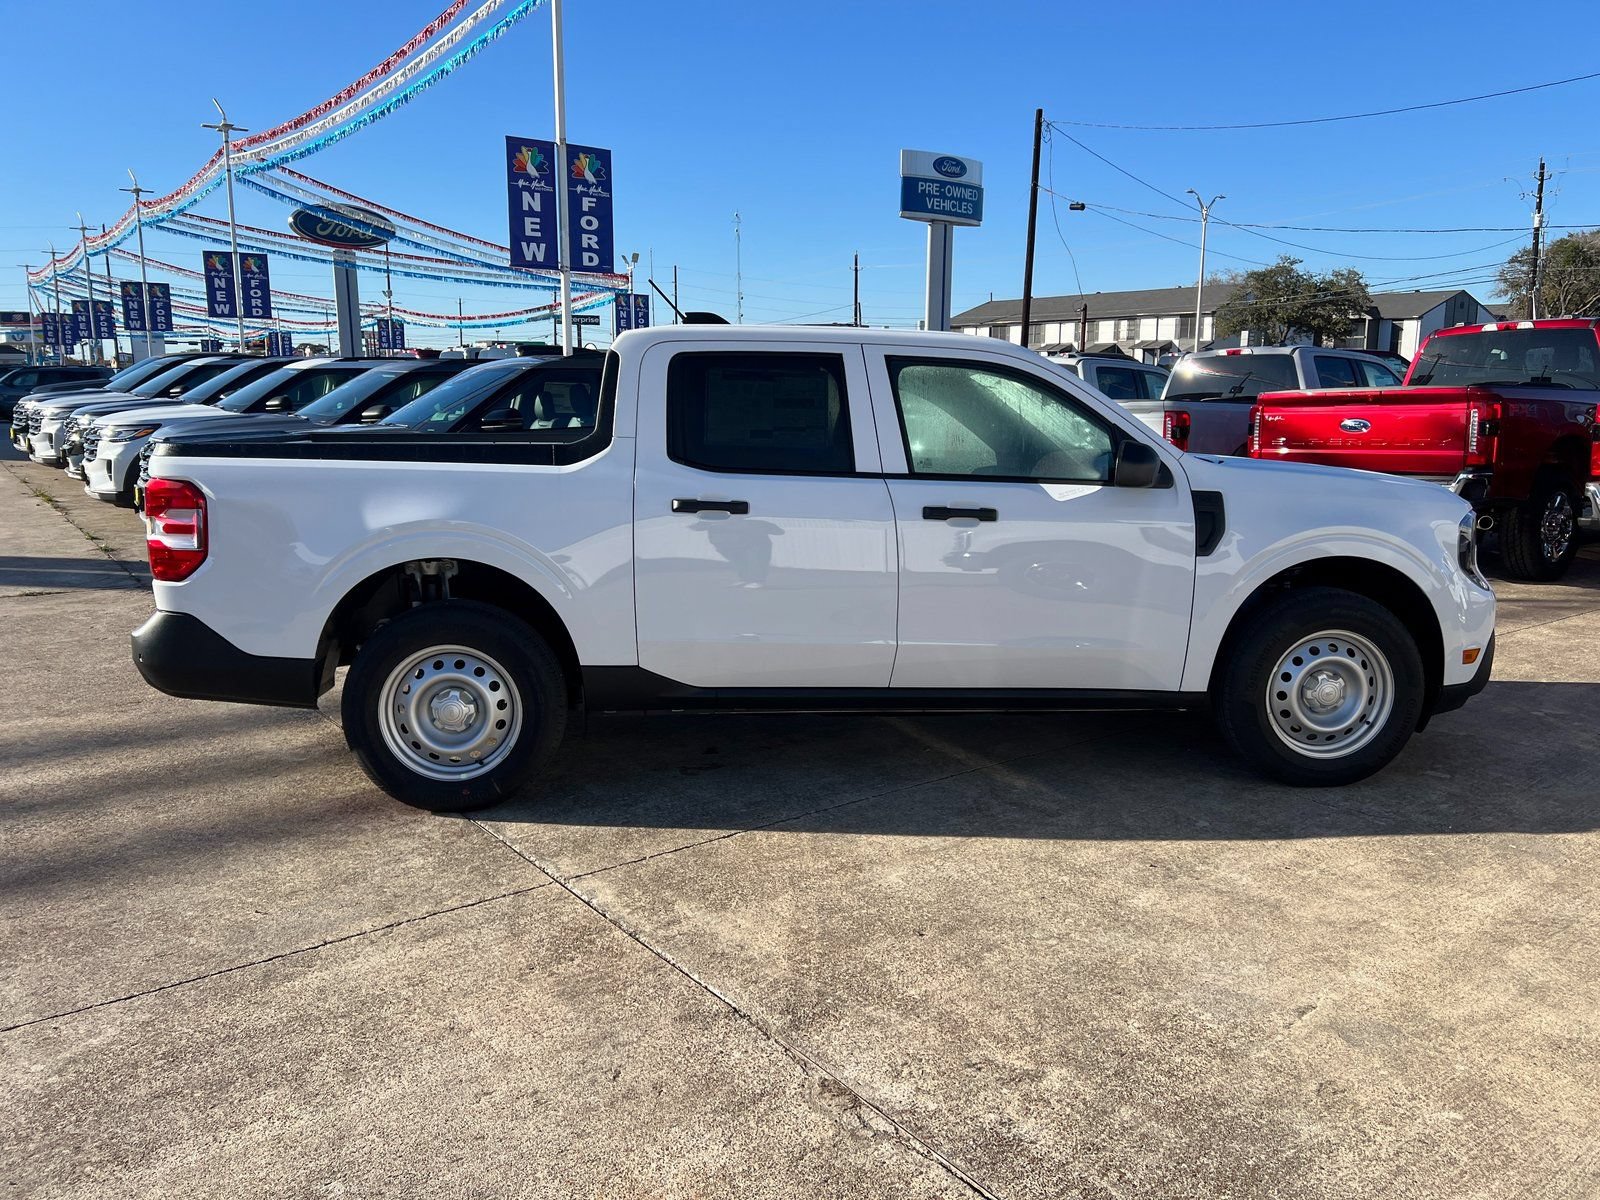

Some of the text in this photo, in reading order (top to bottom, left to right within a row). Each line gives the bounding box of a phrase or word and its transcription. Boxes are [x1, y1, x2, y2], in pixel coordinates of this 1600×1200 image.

[941, 159, 961, 173] Ford
[918, 182, 979, 201] PRE-OWNED
[926, 197, 973, 214] VEHICLES
[521, 191, 546, 262] NEW
[580, 197, 600, 266] FORD
[214, 277, 230, 315] NEW
[250, 279, 263, 316] FORD
[77, 315, 88, 337] NEW
[128, 301, 141, 329] NEW
[156, 302, 166, 330] FORD
[46, 325, 55, 343] NEW
[64, 326, 72, 344] FORD
[100, 316, 109, 338] FORD
